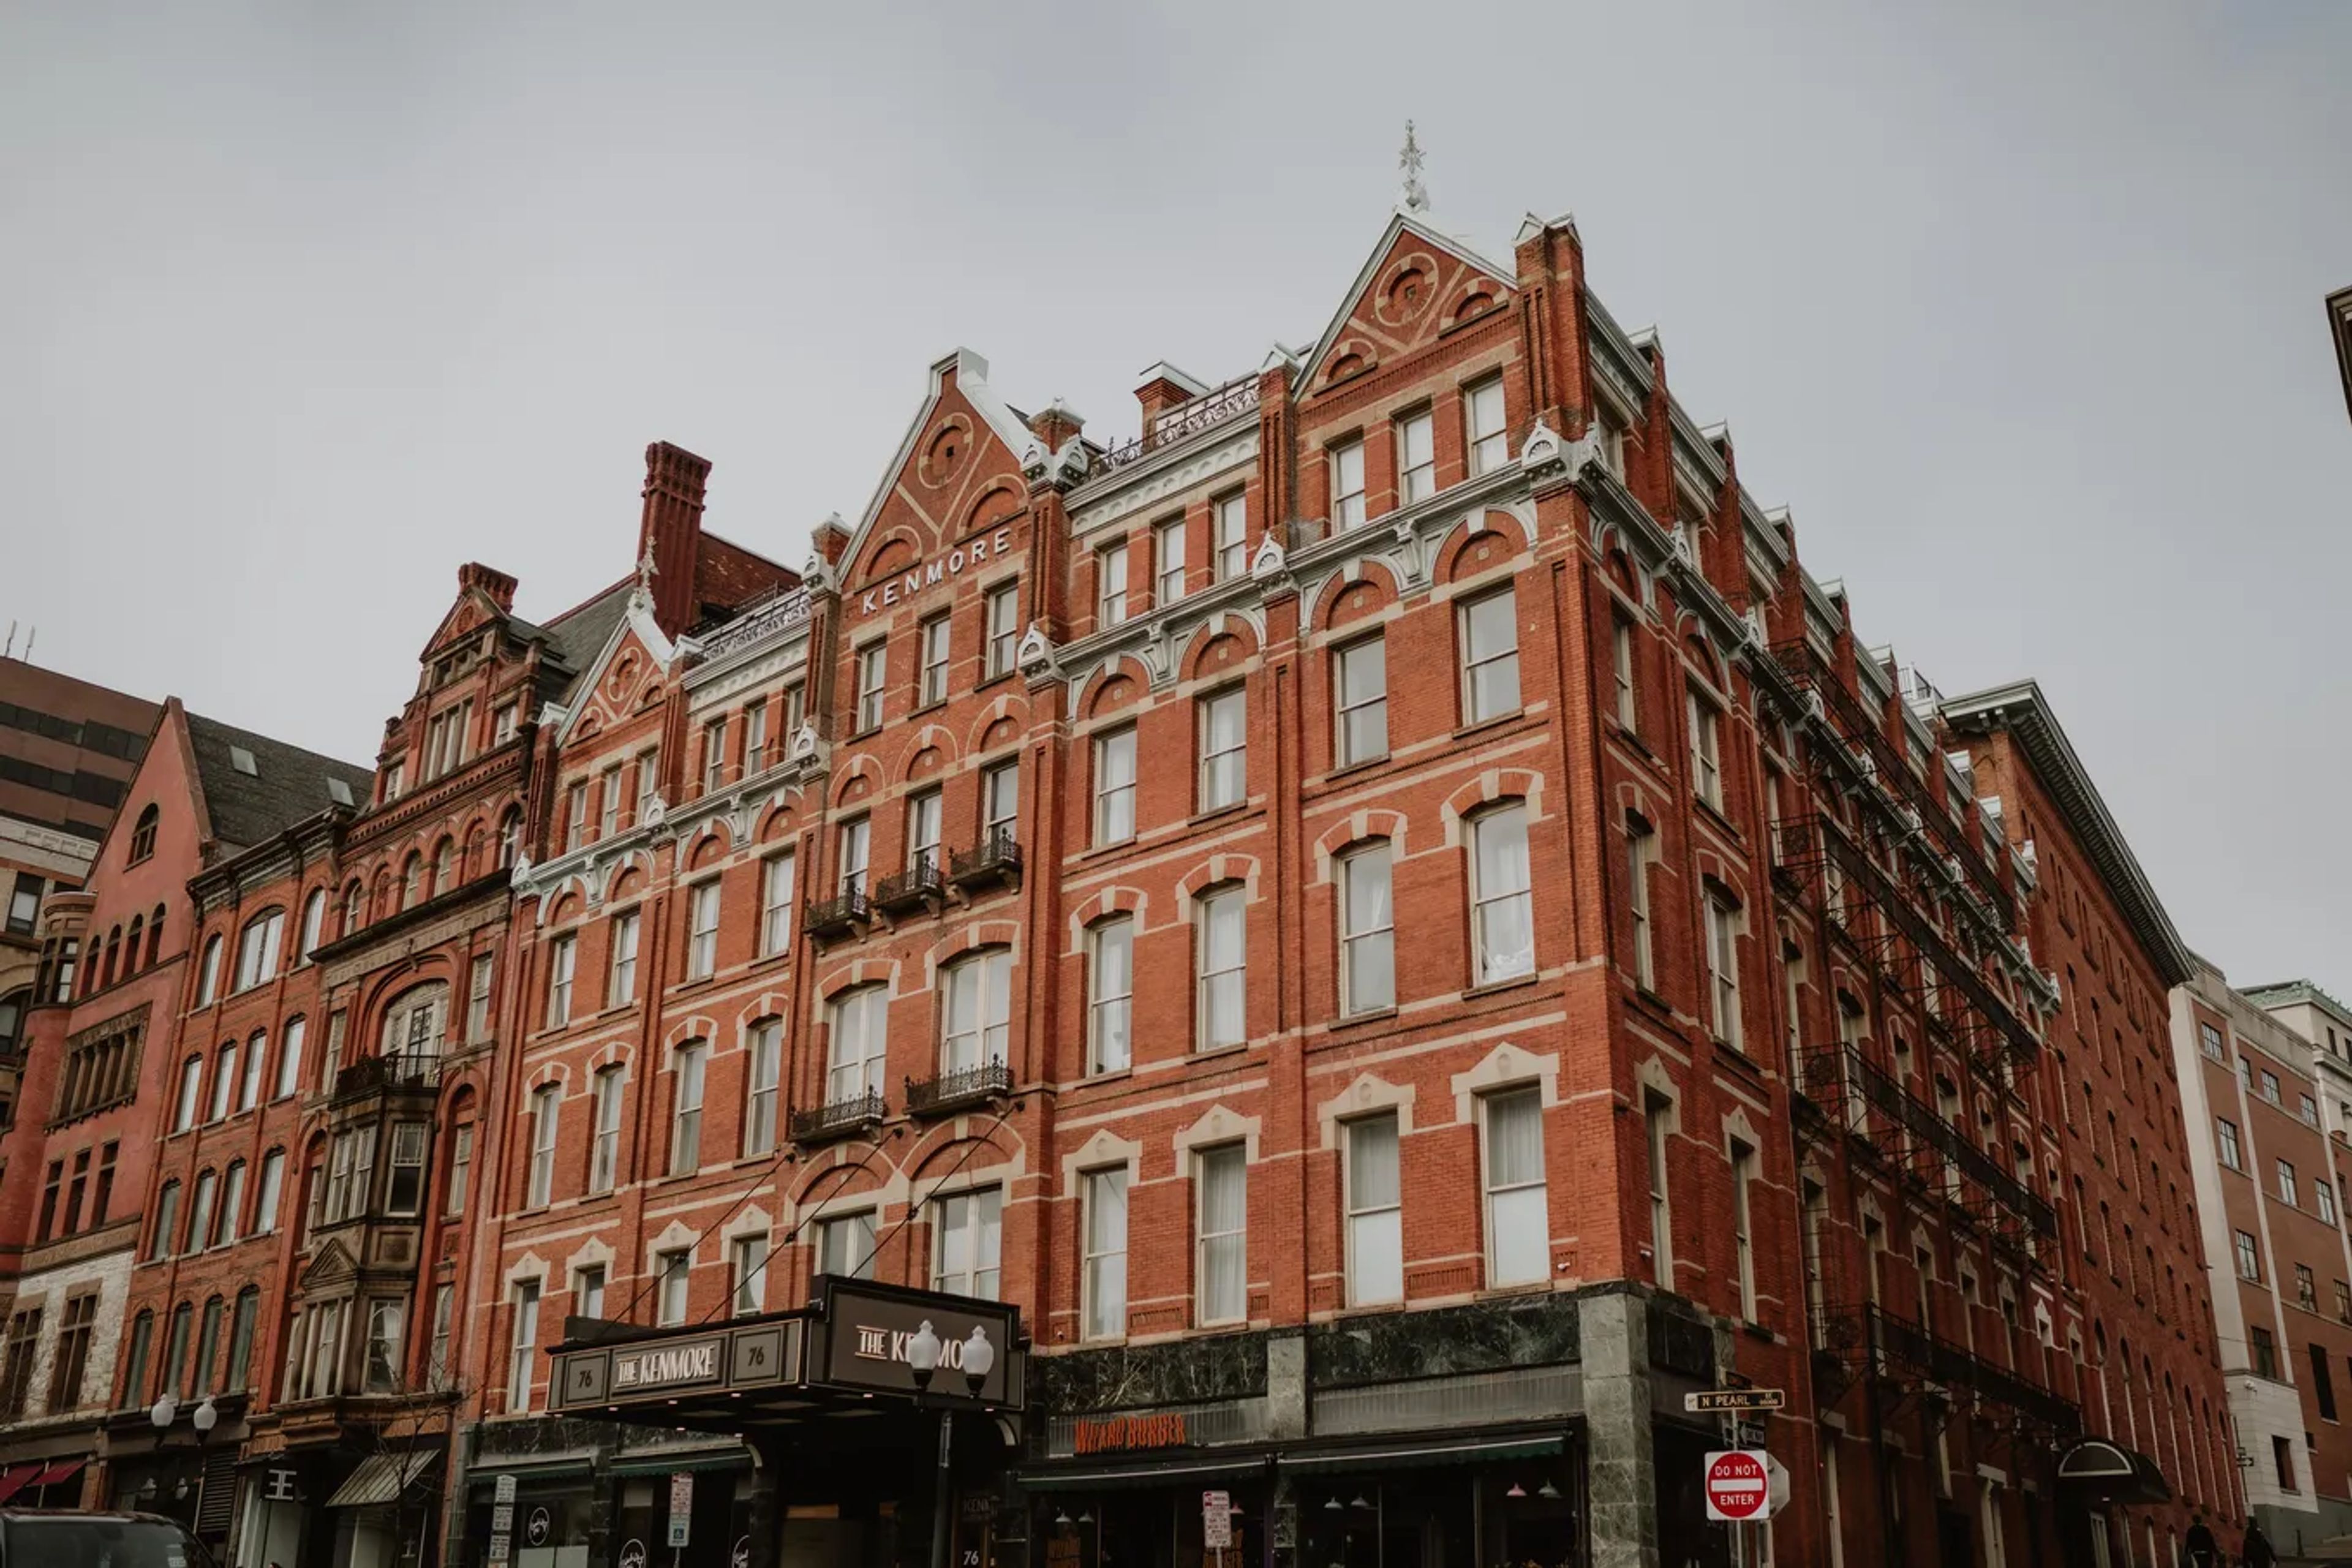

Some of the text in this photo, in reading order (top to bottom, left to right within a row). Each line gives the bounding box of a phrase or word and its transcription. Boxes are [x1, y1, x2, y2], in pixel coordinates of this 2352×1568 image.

[862, 527, 1011, 616] KENMORE
[859, 1330, 886, 1355] THE
[617, 1346, 715, 1384] THE KENMORE
[748, 1346, 764, 1366] 76
[579, 1370, 593, 1388] 76
[1702, 1396, 1709, 1406] N
[1715, 1395, 1751, 1407] PEARL
[1075, 1411, 1186, 1454] WIZARD BURGER
[1715, 1464, 1758, 1477] DO NOT
[1719, 1494, 1755, 1506] ENTER
[963, 1550, 979, 1566] 76
